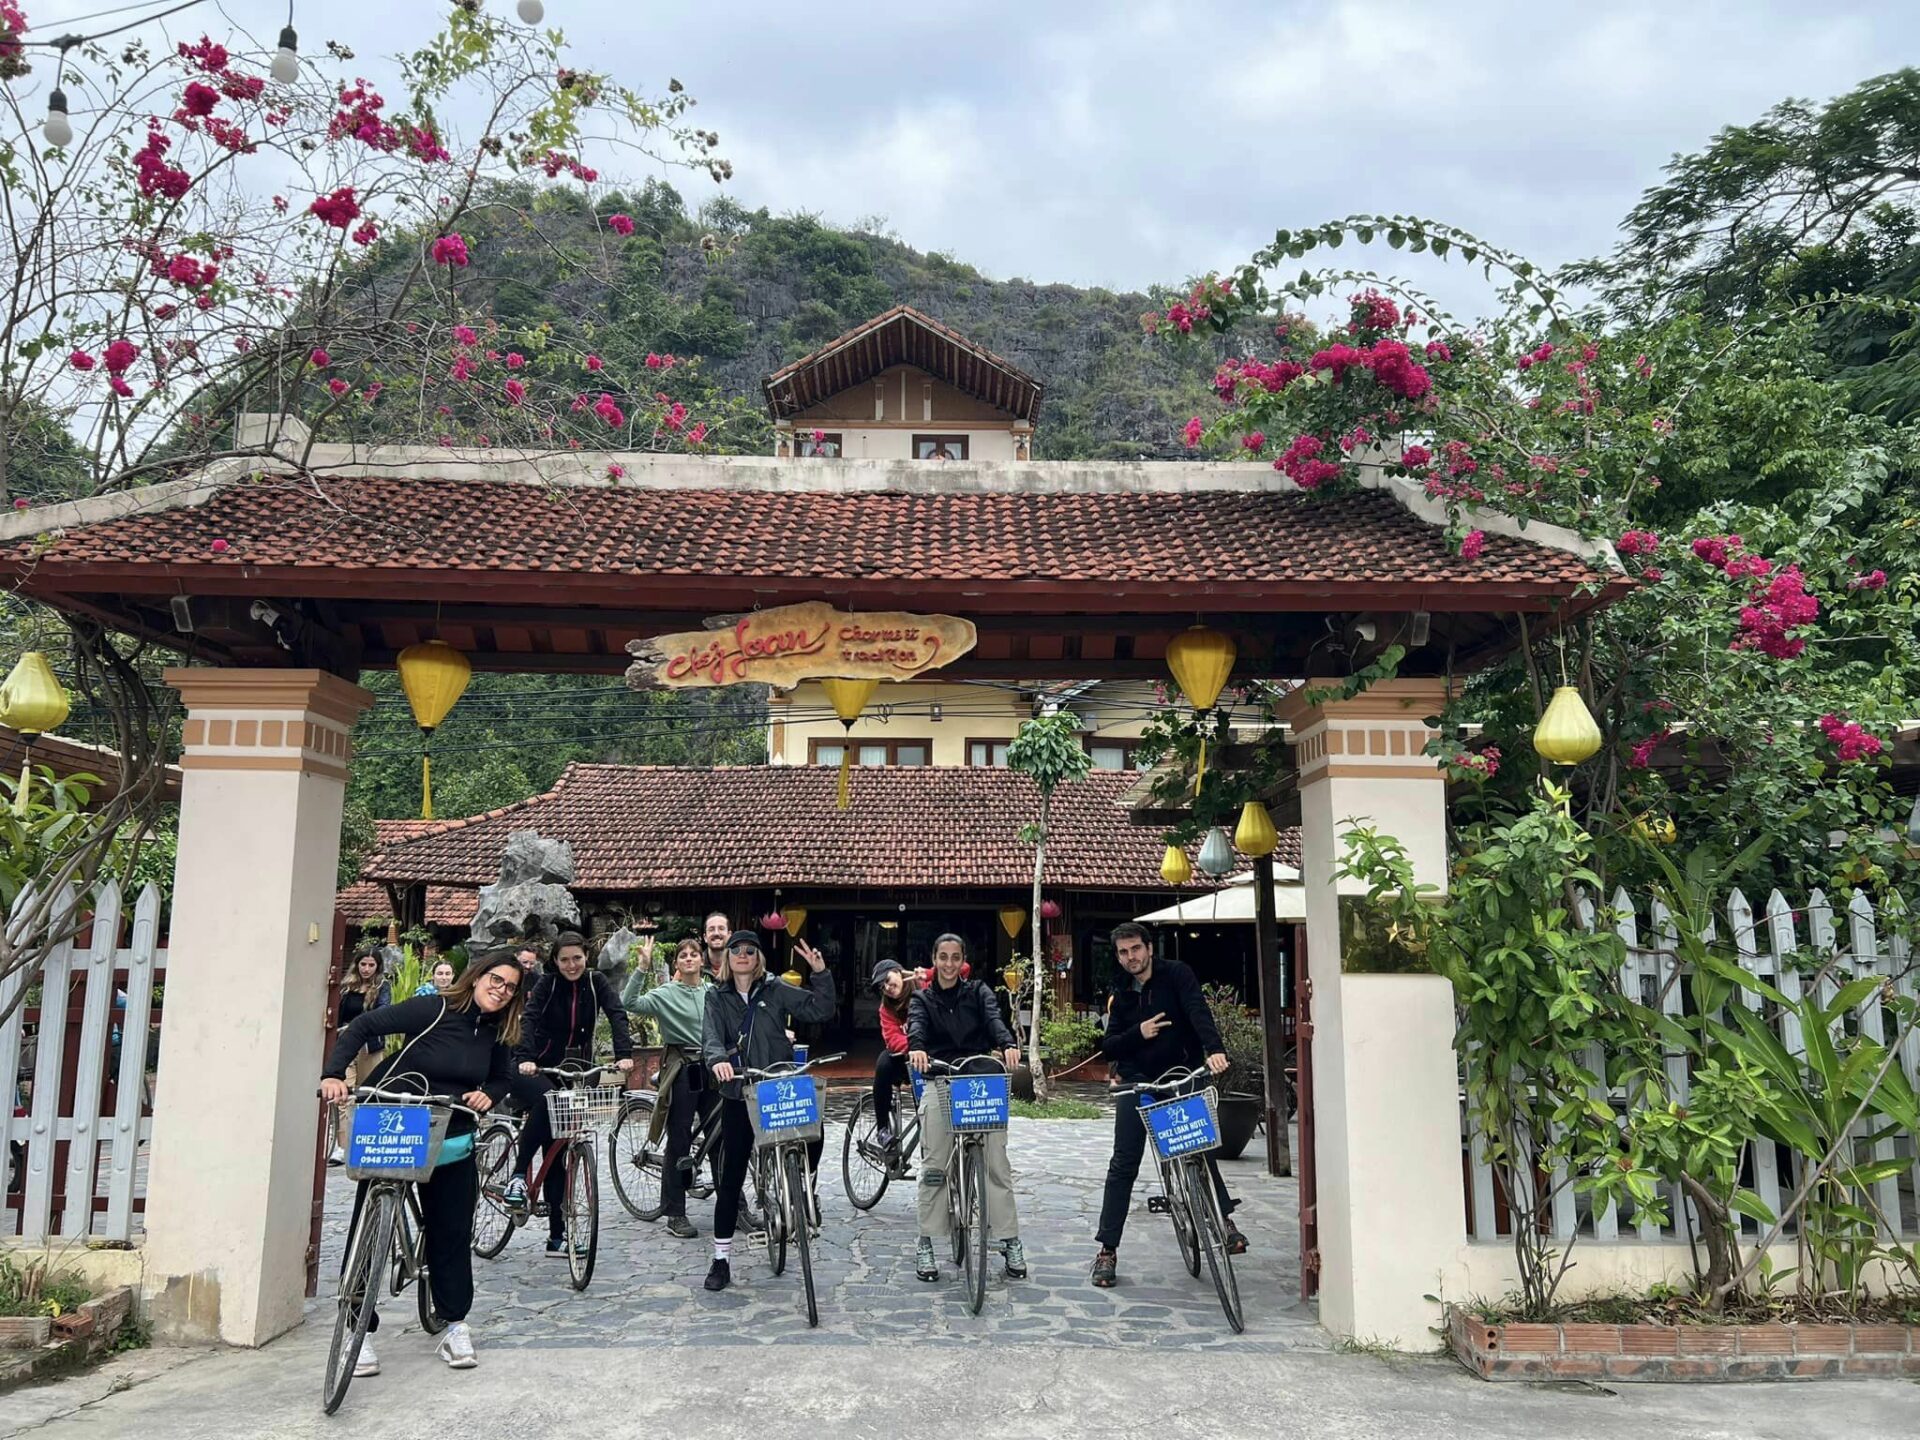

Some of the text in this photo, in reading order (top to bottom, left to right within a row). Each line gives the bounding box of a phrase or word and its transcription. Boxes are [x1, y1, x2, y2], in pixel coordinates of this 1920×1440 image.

[904, 627, 920, 641] et
[762, 1099, 813, 1113] CHEZ LOAN HOTEL
[955, 1098, 1004, 1109] CHEZ LOAN HOTEL
[771, 1109, 807, 1120] Restaurant
[963, 1108, 997, 1116] Restaurant
[786, 1118, 797, 1126] 577
[1158, 1118, 1209, 1140] CHEZ LOAN HOTEL
[355, 1135, 424, 1145] CHEZ LOAN HOTEL
[1168, 1130, 1204, 1144] Restaurant
[364, 1146, 413, 1154] Restaurant
[1185, 1141, 1196, 1149] 577
[360, 1156, 415, 1164] 0948 577 322
